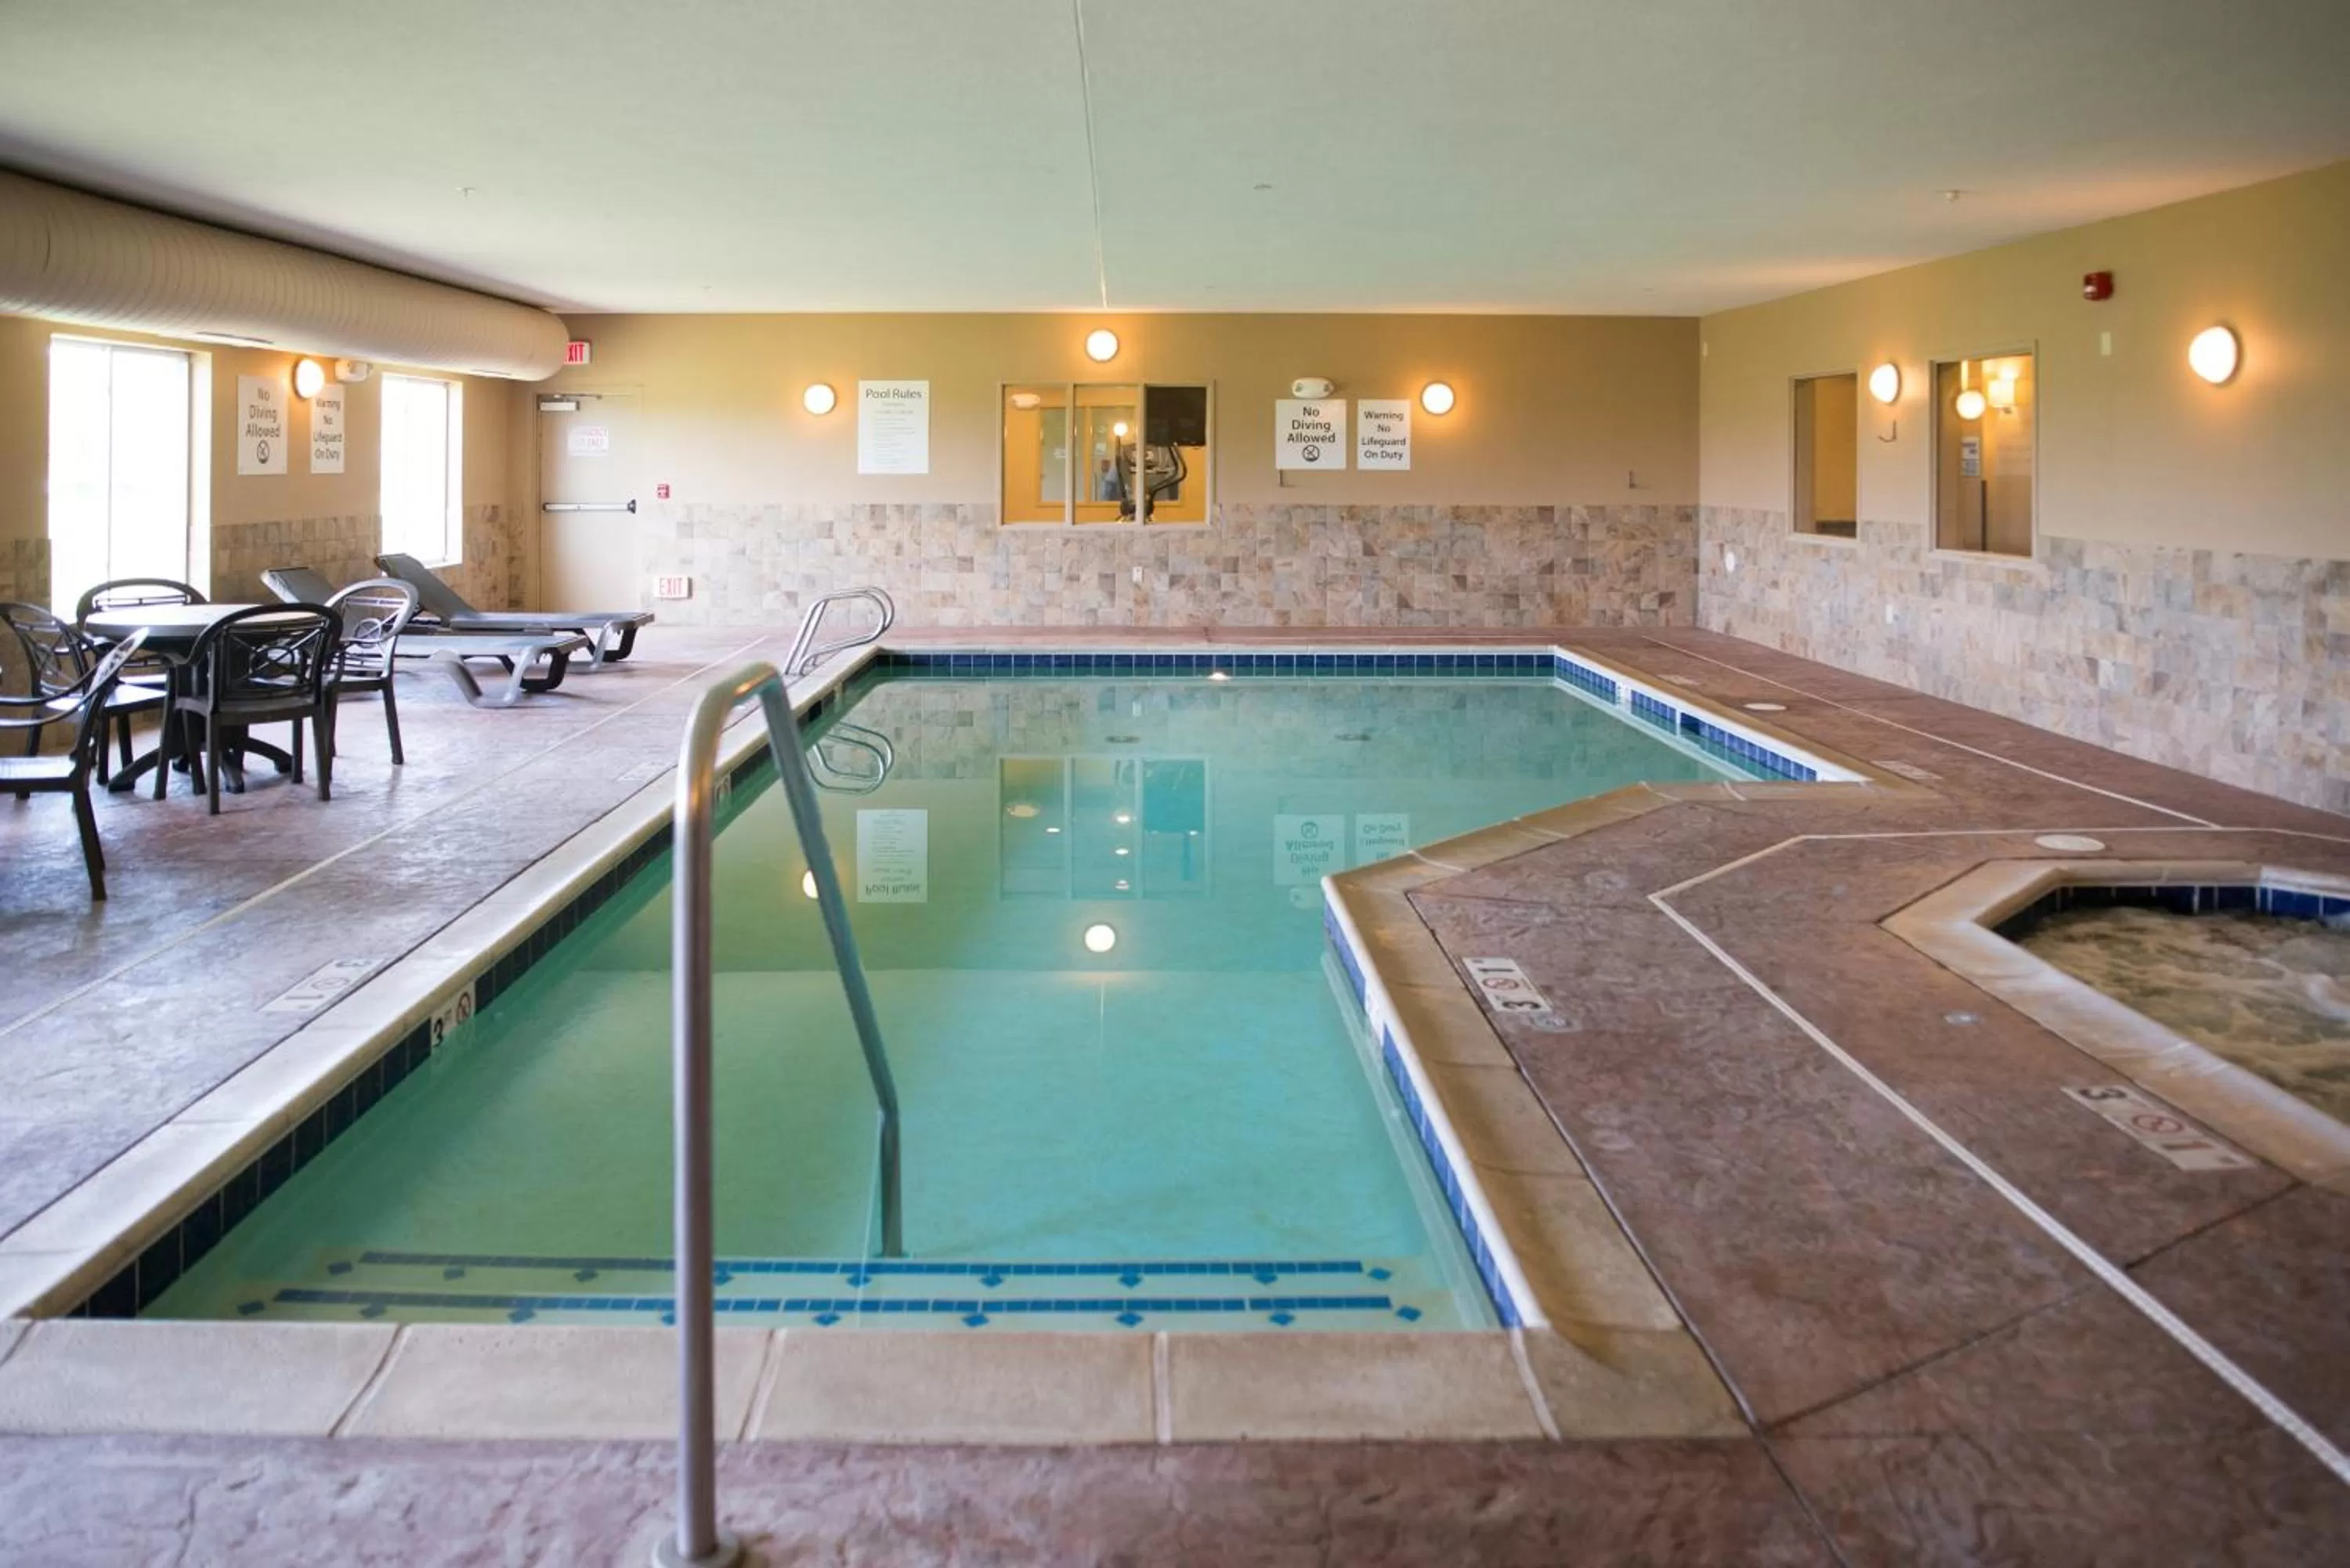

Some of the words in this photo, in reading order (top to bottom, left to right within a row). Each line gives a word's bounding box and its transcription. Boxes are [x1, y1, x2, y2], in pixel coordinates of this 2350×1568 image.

[565, 344, 584, 362] XIT
[258, 388, 270, 401] No
[866, 388, 891, 399] Pool
[892, 388, 922, 399] Rules
[249, 404, 277, 423] Diving
[1303, 406, 1320, 417] No
[1364, 410, 1404, 421] Warning
[246, 424, 280, 438] Allowed
[1292, 419, 1332, 432] Diving
[1377, 424, 1390, 432] No
[1287, 432, 1336, 443] Allowed
[1361, 437, 1406, 448] Lifeguard
[1364, 450, 1378, 459] On
[1380, 450, 1403, 461] Duty
[659, 577, 683, 595] EXIT
